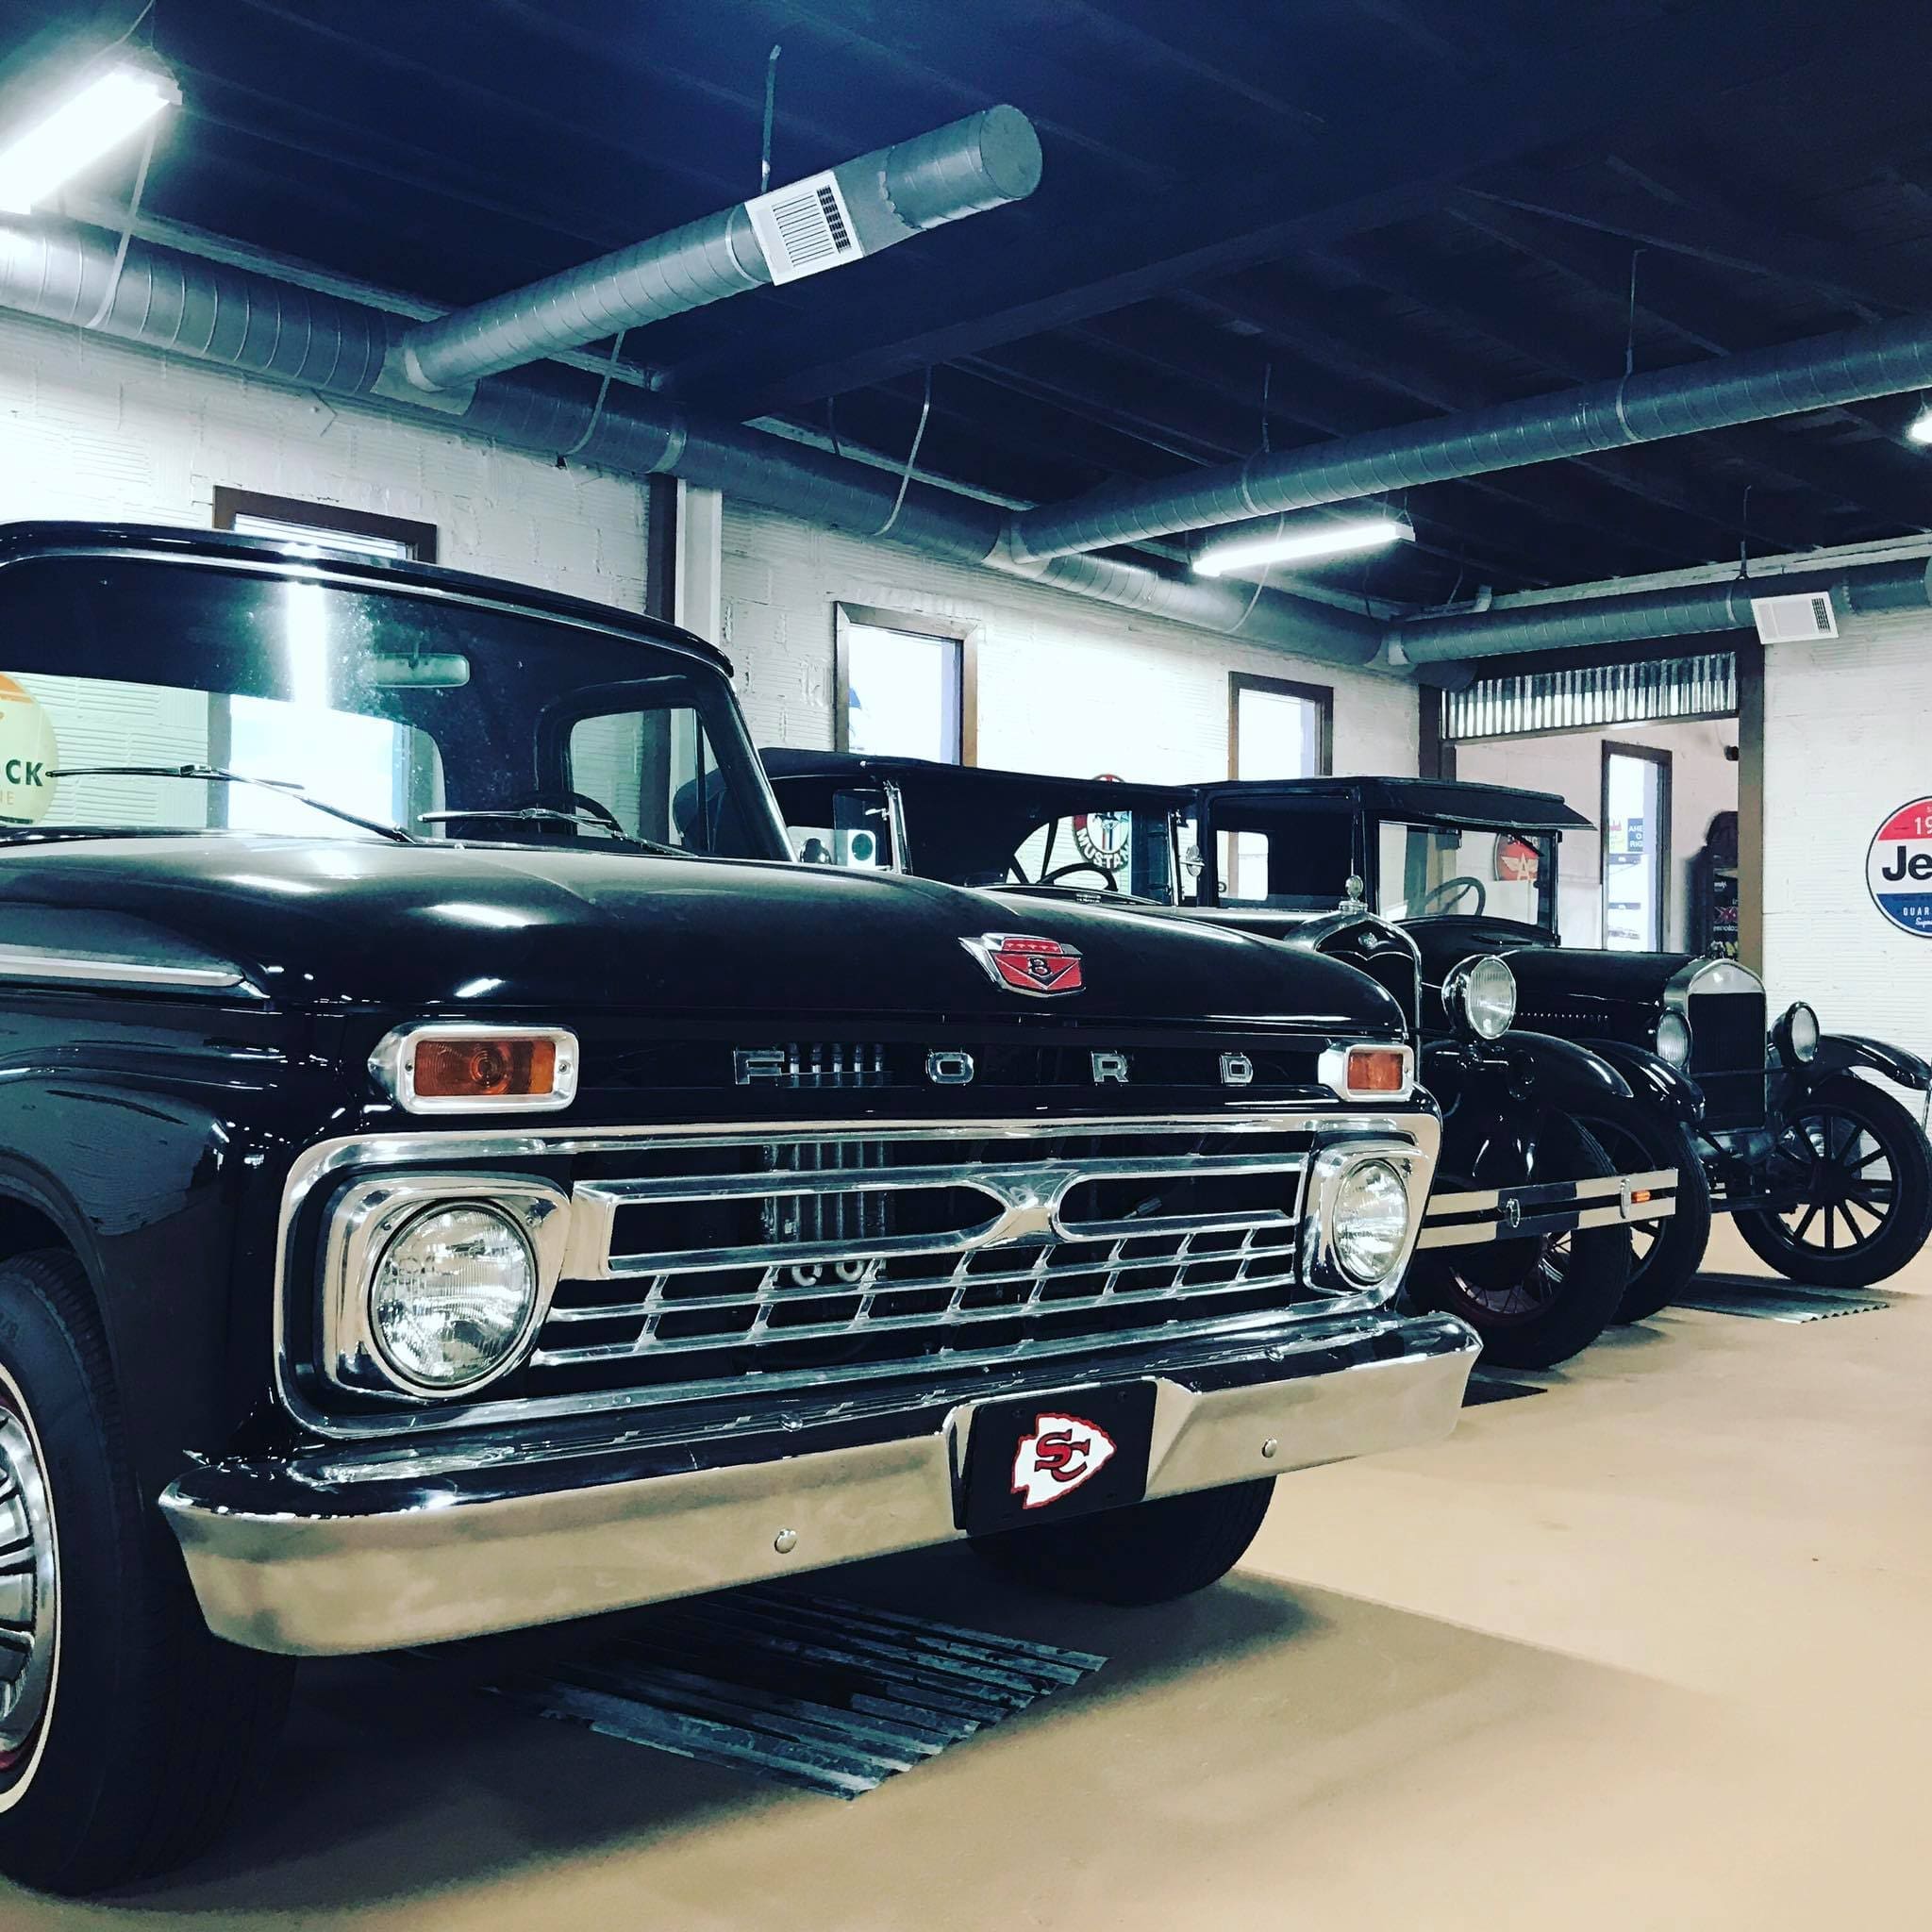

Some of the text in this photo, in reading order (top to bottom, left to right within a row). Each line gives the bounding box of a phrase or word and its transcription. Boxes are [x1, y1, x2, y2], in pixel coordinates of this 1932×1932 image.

[1076, 827, 1130, 869] MUSTAN
[1882, 846, 1932, 881] Je
[734, 1049, 1254, 1086] FORD
